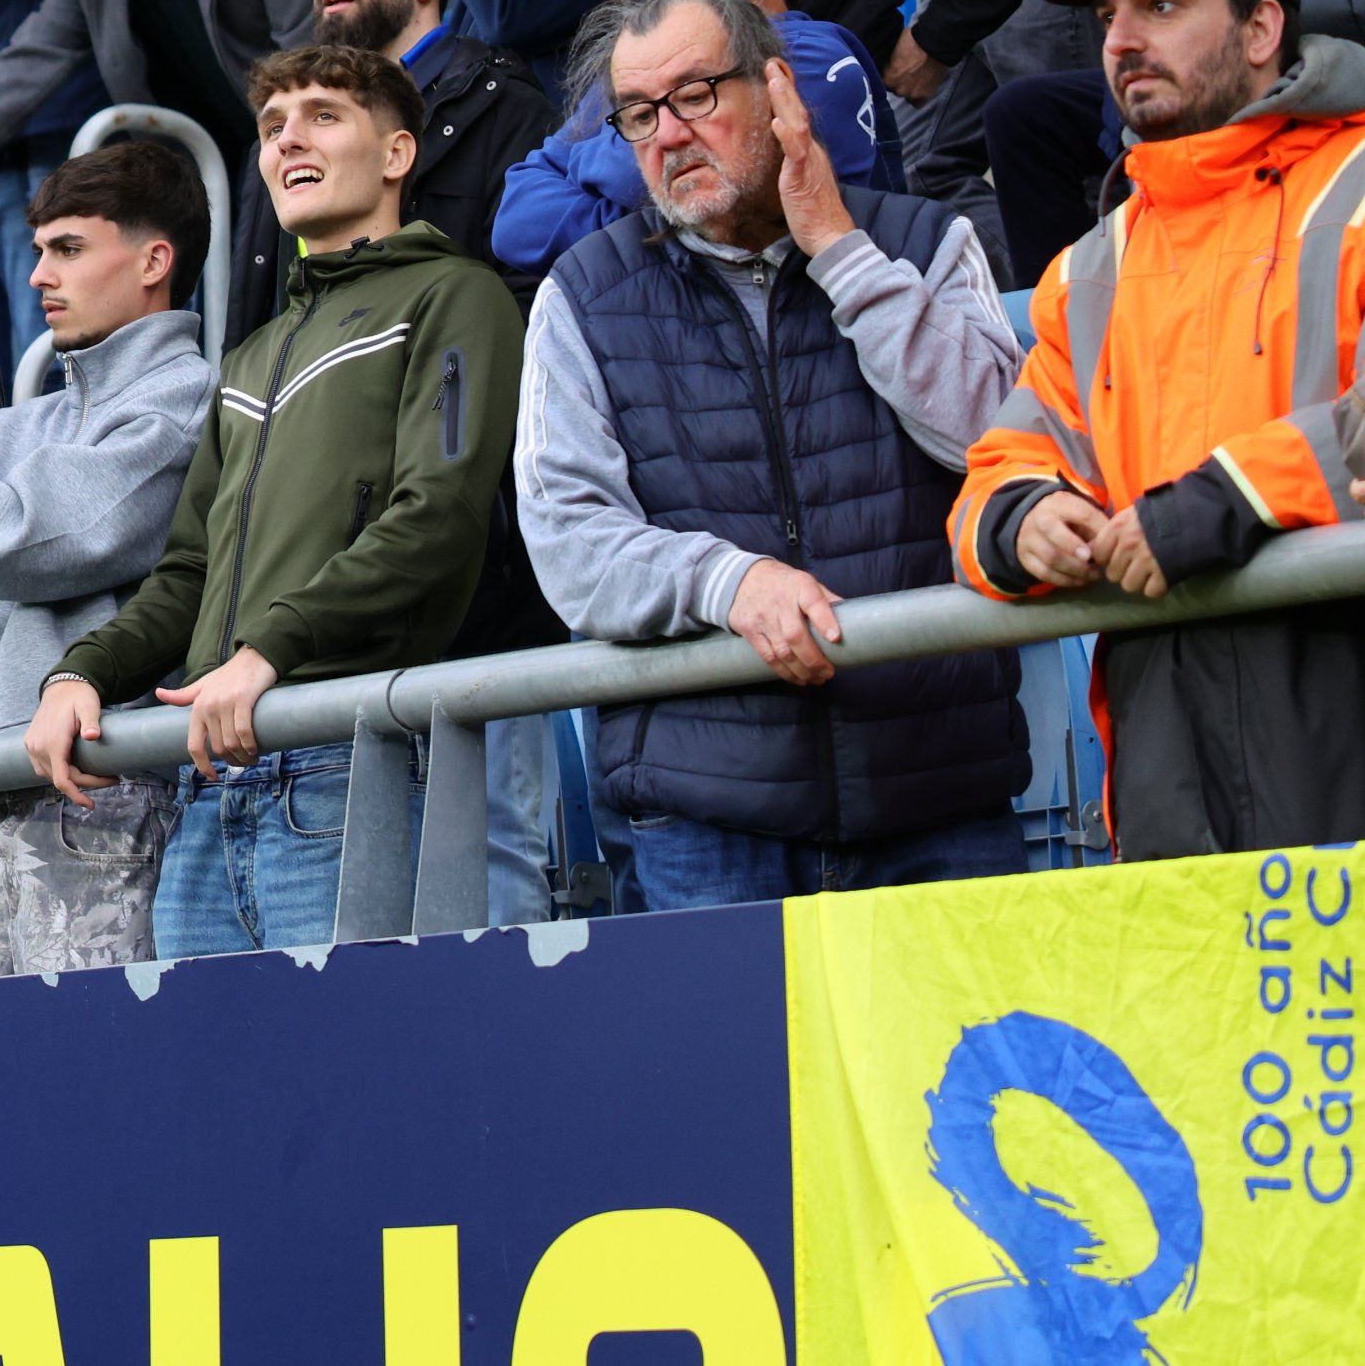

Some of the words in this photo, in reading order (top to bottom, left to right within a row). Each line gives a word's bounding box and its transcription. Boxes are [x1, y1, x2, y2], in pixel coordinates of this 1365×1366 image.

[1243, 852, 1292, 1015] año
[1241, 1049, 1292, 1202] 100
[1302, 955, 1355, 1205] Cádiz
